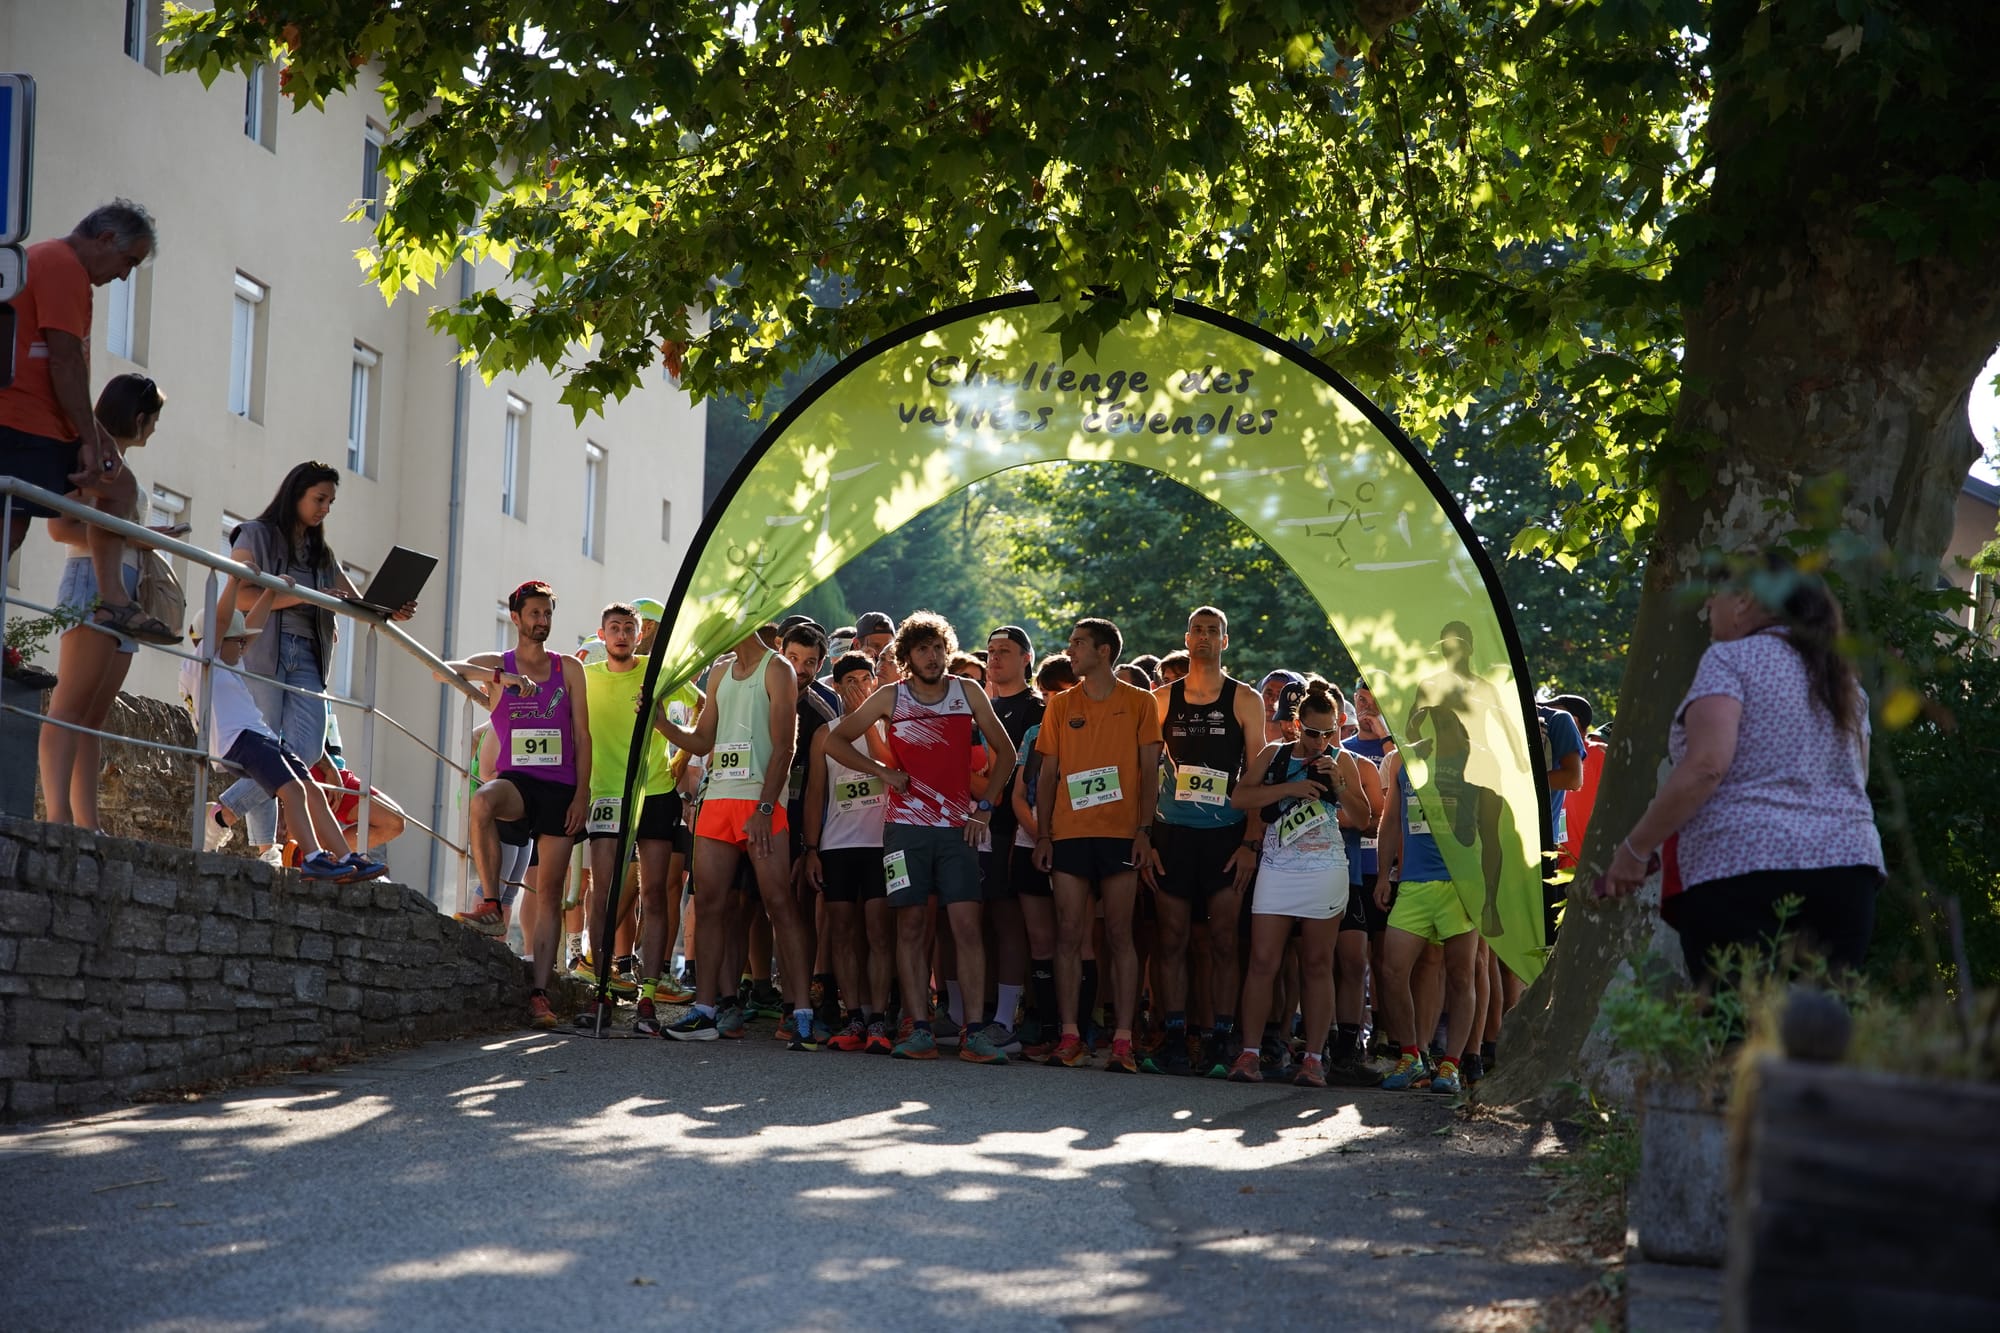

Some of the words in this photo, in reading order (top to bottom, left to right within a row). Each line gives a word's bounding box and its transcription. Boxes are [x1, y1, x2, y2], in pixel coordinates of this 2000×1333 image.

[926, 355, 1149, 404] Challenge
[1180, 364, 1255, 395] des
[898, 402, 1054, 433] vallées
[1082, 402, 1278, 436] cévenoles
[525, 738, 548, 754] 91
[721, 753, 739, 767] 99
[846, 781, 871, 799] 38
[1079, 777, 1106, 795] 73
[1189, 775, 1214, 792] 94
[593, 806, 613, 821] 08
[1284, 805, 1317, 831] 101
